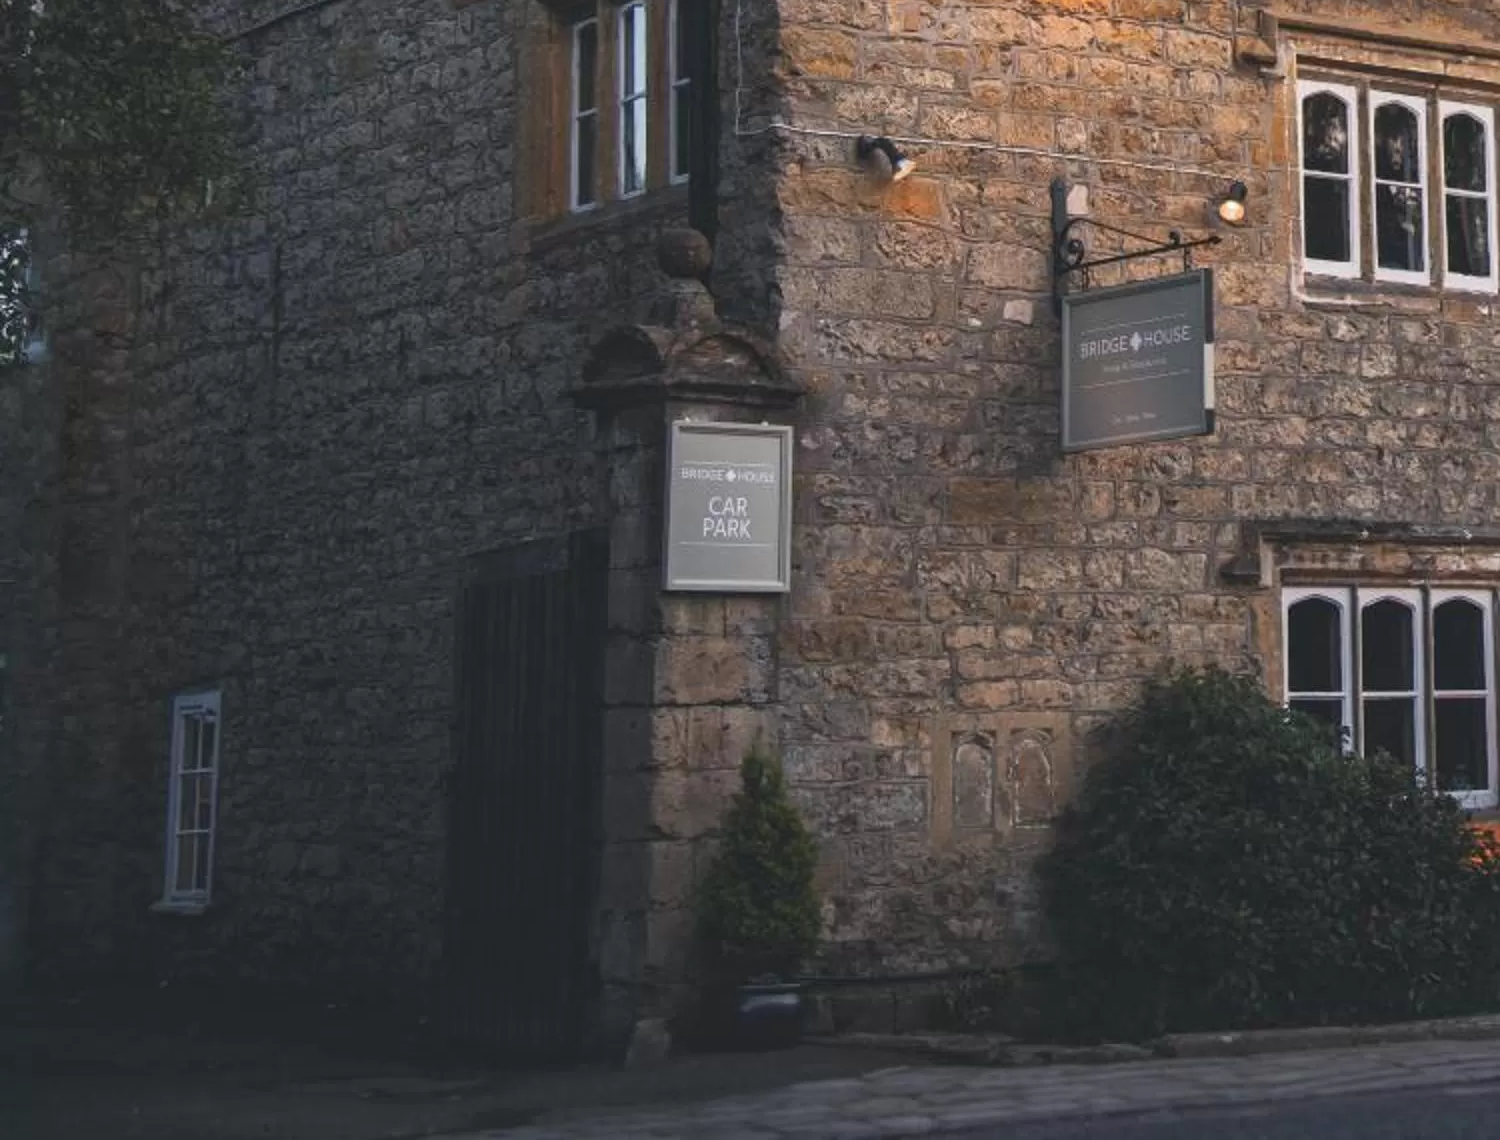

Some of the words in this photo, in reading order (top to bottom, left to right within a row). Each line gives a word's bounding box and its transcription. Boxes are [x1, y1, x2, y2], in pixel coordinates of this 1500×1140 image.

[1080, 335, 1129, 360] BRIDGE
[1143, 325, 1193, 348] HOUSE
[681, 467, 726, 481] BRIDGE
[737, 471, 776, 484] HOUSE
[708, 496, 749, 517] CAR
[703, 518, 751, 539] PARK
